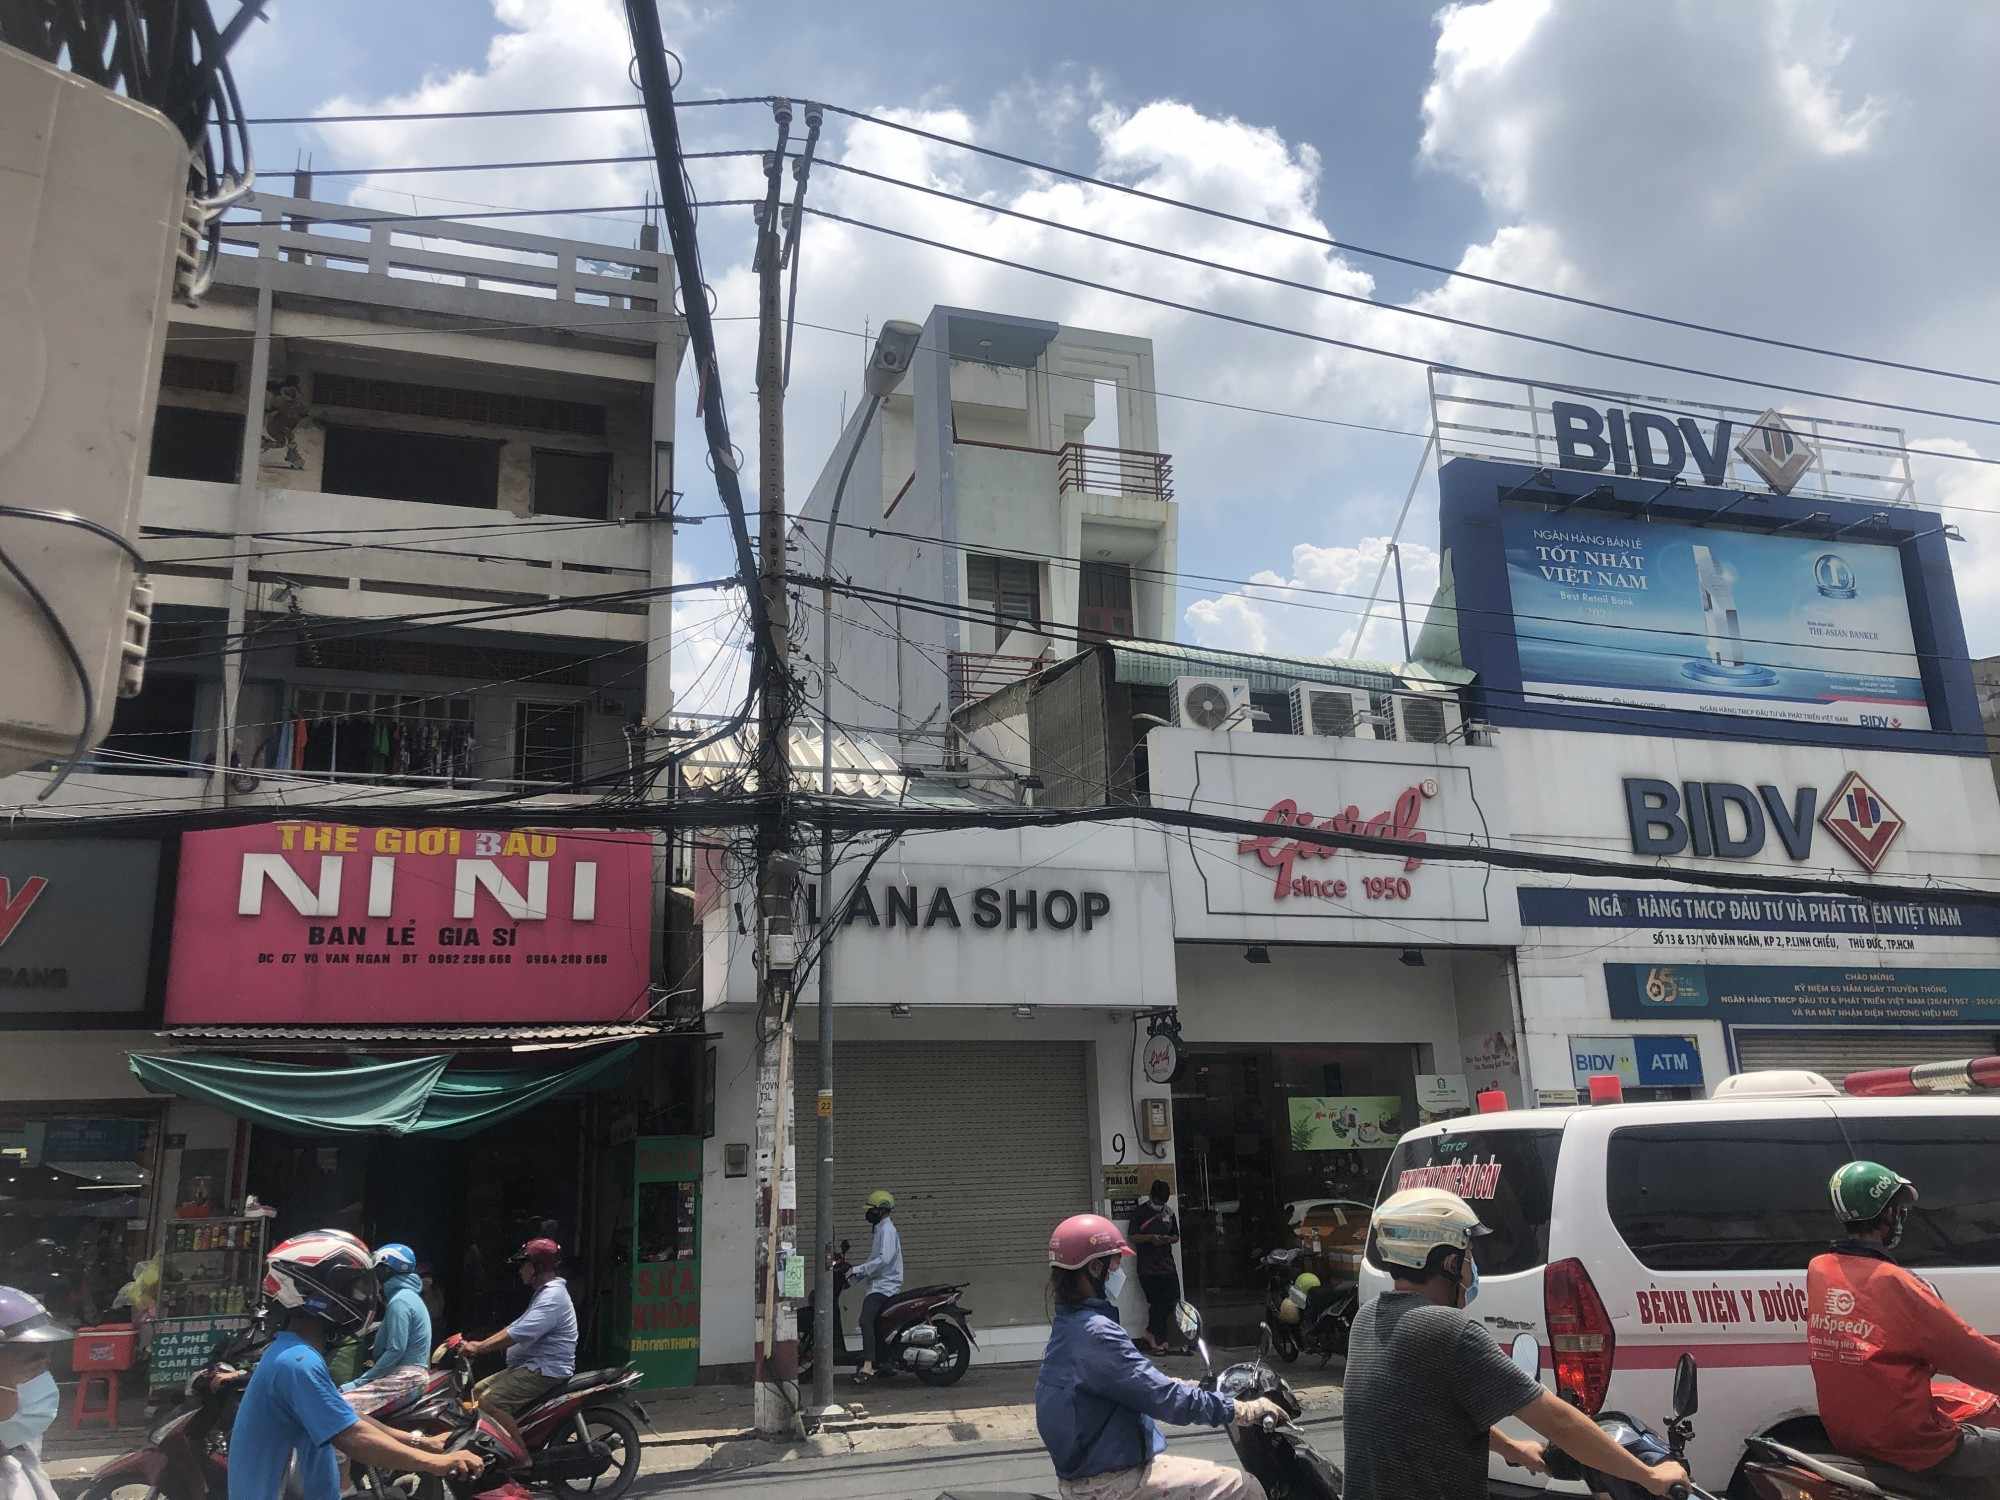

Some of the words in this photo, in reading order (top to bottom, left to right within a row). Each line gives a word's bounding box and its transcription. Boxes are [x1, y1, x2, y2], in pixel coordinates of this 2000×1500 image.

[1552, 401, 1732, 485] BIDV
[1536, 544, 1579, 563] TỐT
[1584, 551, 1644, 570] NHẤT
[1538, 565, 1592, 586] VIỆT
[1597, 571, 1648, 590] NAM
[1560, 591, 1579, 601] Best
[1582, 593, 1608, 603] Retail
[1612, 595, 1633, 605] Bank
[1860, 714, 1889, 728] BIDV
[1622, 778, 1817, 860] BIDV
[238, 853, 395, 917] NI
[454, 859, 597, 921] NI
[1292, 875, 1348, 899] since
[1362, 876, 1411, 900] 1950
[973, 886, 1111, 930] SHOP
[1637, 894, 1681, 919] HÀNG
[1683, 897, 1725, 920] TMCP
[1763, 900, 1785, 921] TƯ
[1787, 897, 1807, 922] VÀ
[1809, 899, 1846, 923] PHÁT
[1928, 905, 1962, 927] NAM
[1665, 934, 1676, 945] 13
[1677, 934, 1685, 945] &
[1764, 936, 1775, 947] KP
[1575, 1054, 1615, 1071] BIDV
[1651, 1053, 1689, 1071] ATM
[1112, 1133, 1126, 1165] 9
[1870, 1175, 1892, 1199] Grab
[1635, 1282, 1693, 1333] BỆNH
[1691, 1282, 1742, 1331] VIỆN
[1740, 1289, 1756, 1323] Y
[1758, 1281, 1808, 1332] DƯỢC
[1811, 1313, 1874, 1339] MrSpeedy
[158, 1358, 187, 1369] CAM
